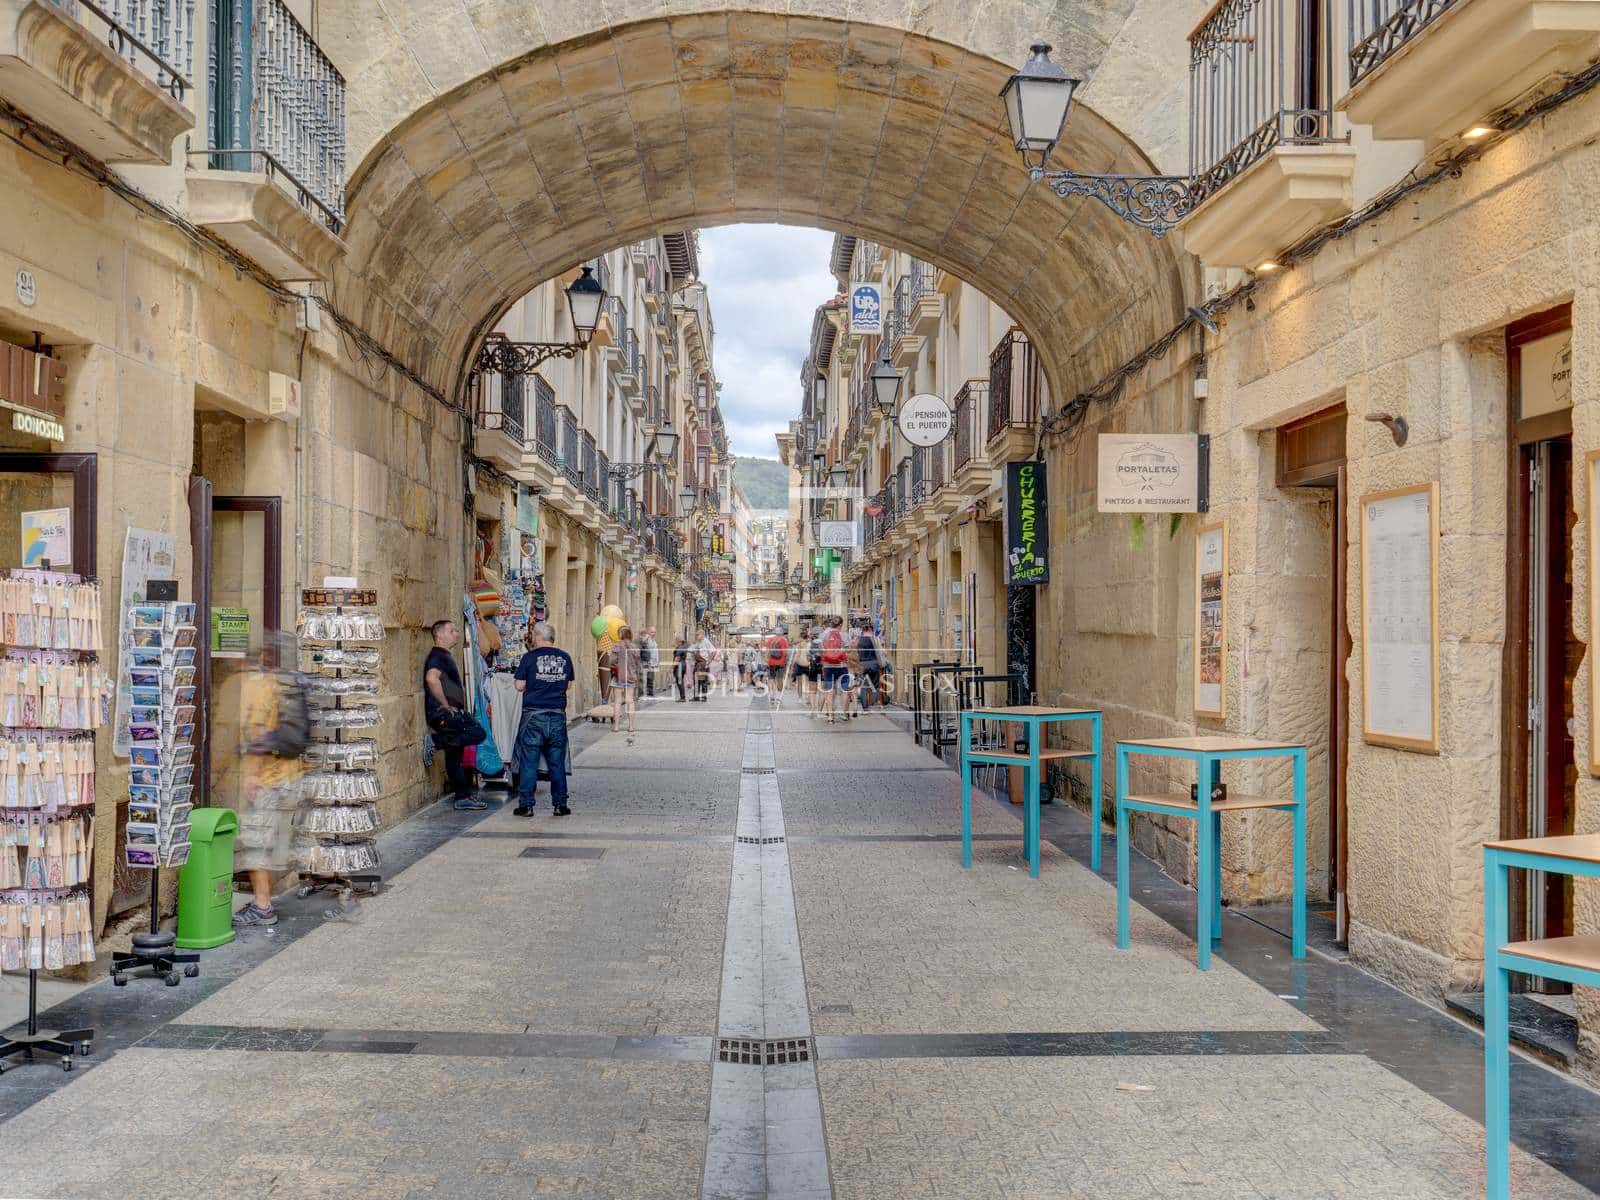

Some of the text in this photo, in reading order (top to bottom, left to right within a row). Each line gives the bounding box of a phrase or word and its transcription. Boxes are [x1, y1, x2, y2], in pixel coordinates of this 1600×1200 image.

[17, 413, 64, 442] DONOSTIA
[906, 421, 948, 430] EL PUERTO
[1118, 465, 1178, 474] PORTALETAS
[1104, 498, 1136, 506] PINTXOS
[1144, 498, 1191, 506] RESTAURANT
[1019, 465, 1036, 564] CHURRERIA
[1011, 566, 1045, 580] PUERTO
[1014, 564, 1024, 574] EL
